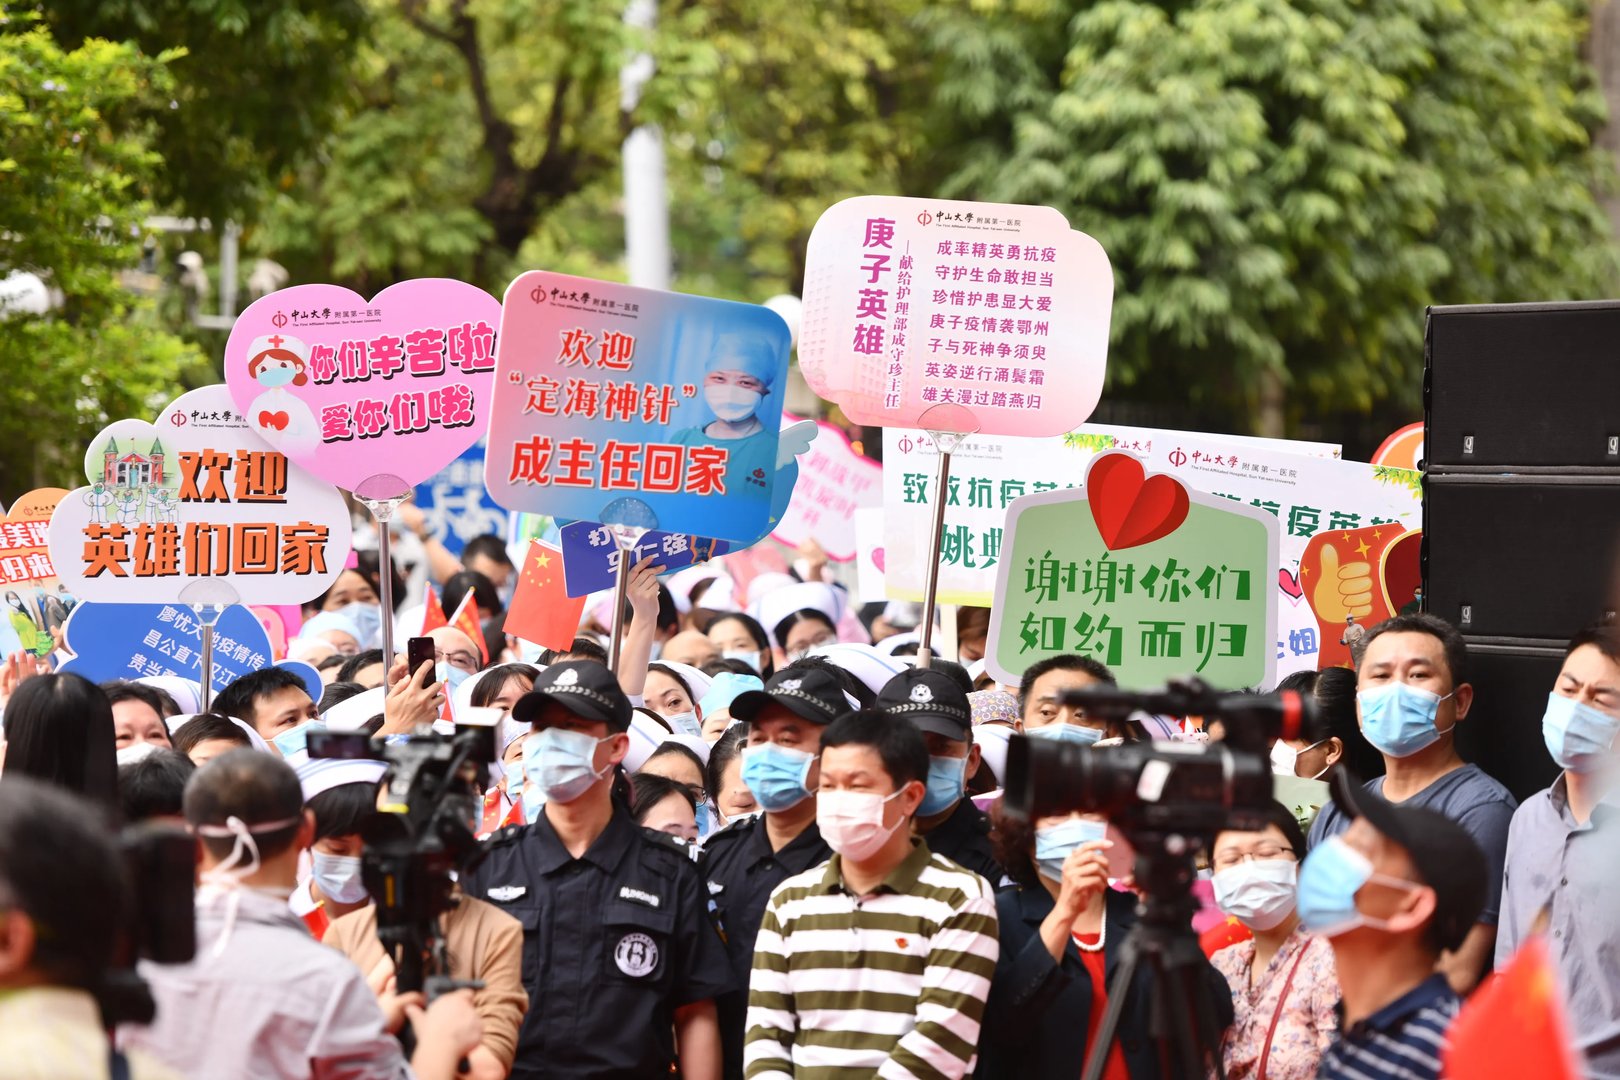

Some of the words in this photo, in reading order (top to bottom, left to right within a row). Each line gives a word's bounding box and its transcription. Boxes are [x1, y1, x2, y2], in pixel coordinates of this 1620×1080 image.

[934, 265, 1054, 287] 守护生命敢担当
[936, 239, 1057, 263] 成率精英勇抗疫
[854, 217, 896, 355] 庚子英雄
[932, 289, 1052, 312] 珍惜护患显大爱
[309, 321, 497, 384] 你们辛苦啦
[556, 327, 637, 371] 欢迎
[928, 337, 1047, 360] 子与死神争须臾
[929, 313, 1049, 336] 庚子疫情袭鄂州
[320, 384, 475, 443] 爱你们哦
[922, 386, 1042, 409] 雄关漫过踏燕归
[178, 448, 289, 504] 欢迎
[508, 434, 730, 496] 成主任回家
[81, 521, 330, 578] 英雄们回家
[1024, 549, 1251, 606] 谢谢你们
[1019, 611, 1248, 673] 如约而归
